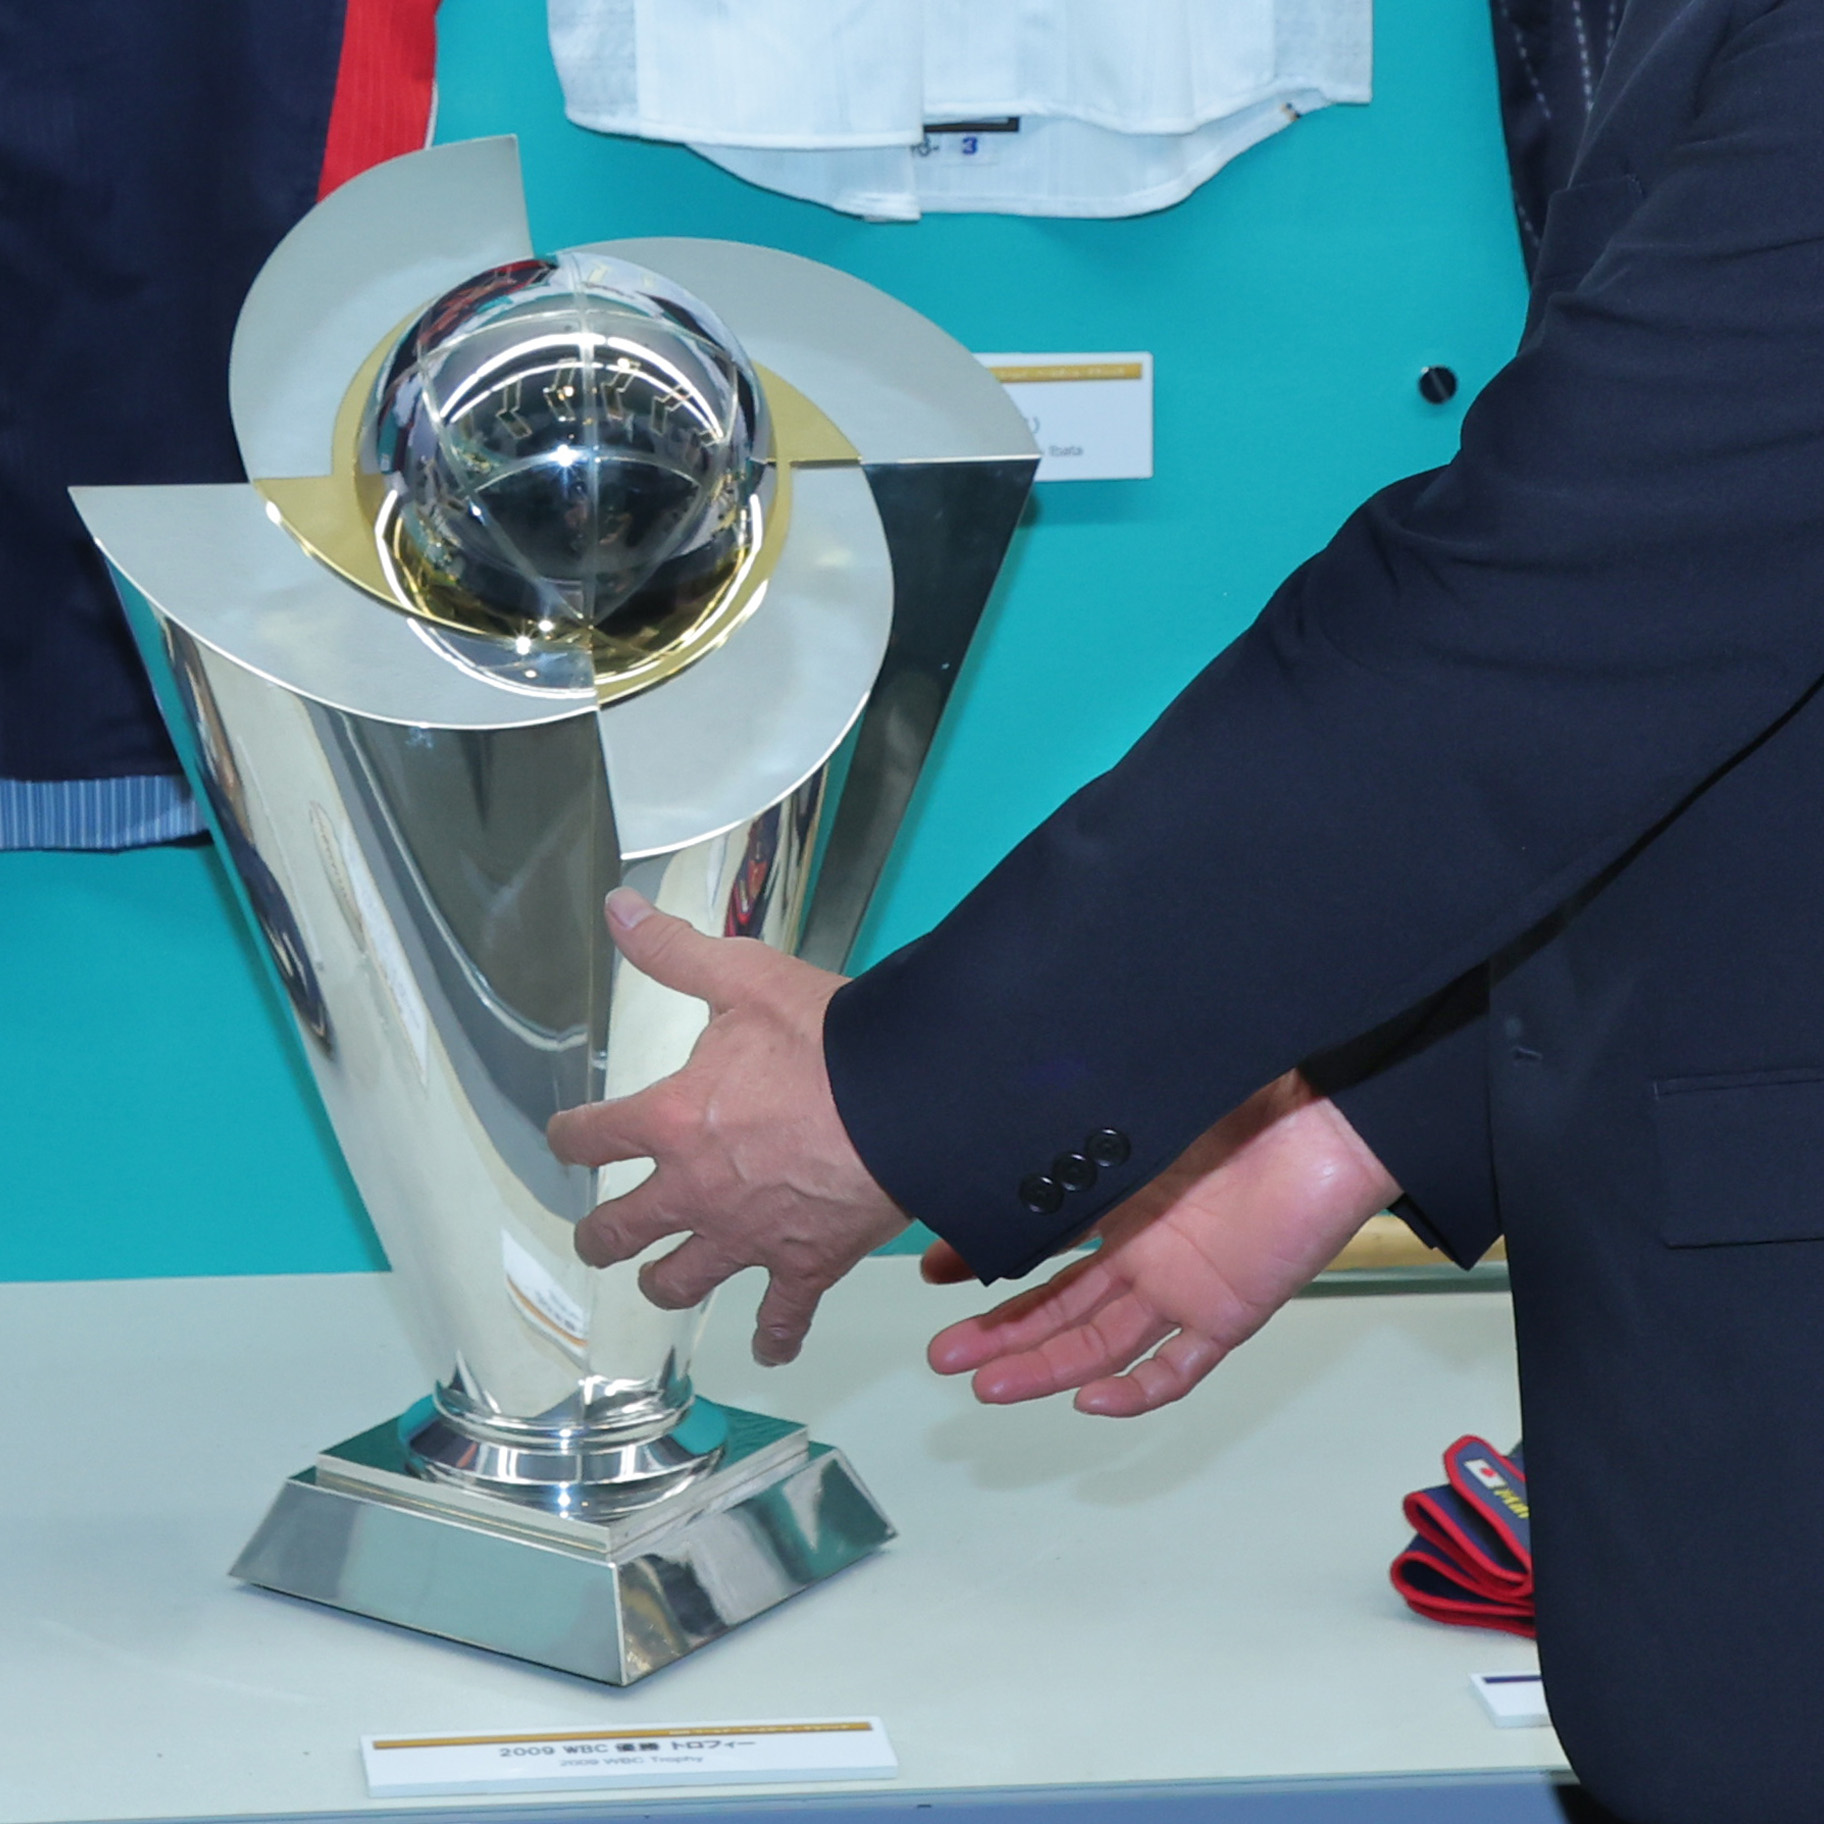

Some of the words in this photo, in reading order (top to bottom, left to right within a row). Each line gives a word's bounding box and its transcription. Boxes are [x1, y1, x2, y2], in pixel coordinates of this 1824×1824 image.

[962, 136, 979, 155] 3
[499, 1746, 555, 1758] 2009
[563, 1743, 608, 1755] WBC
[671, 1738, 756, 1751] トロフィー
[650, 1754, 703, 1765] Trophy
